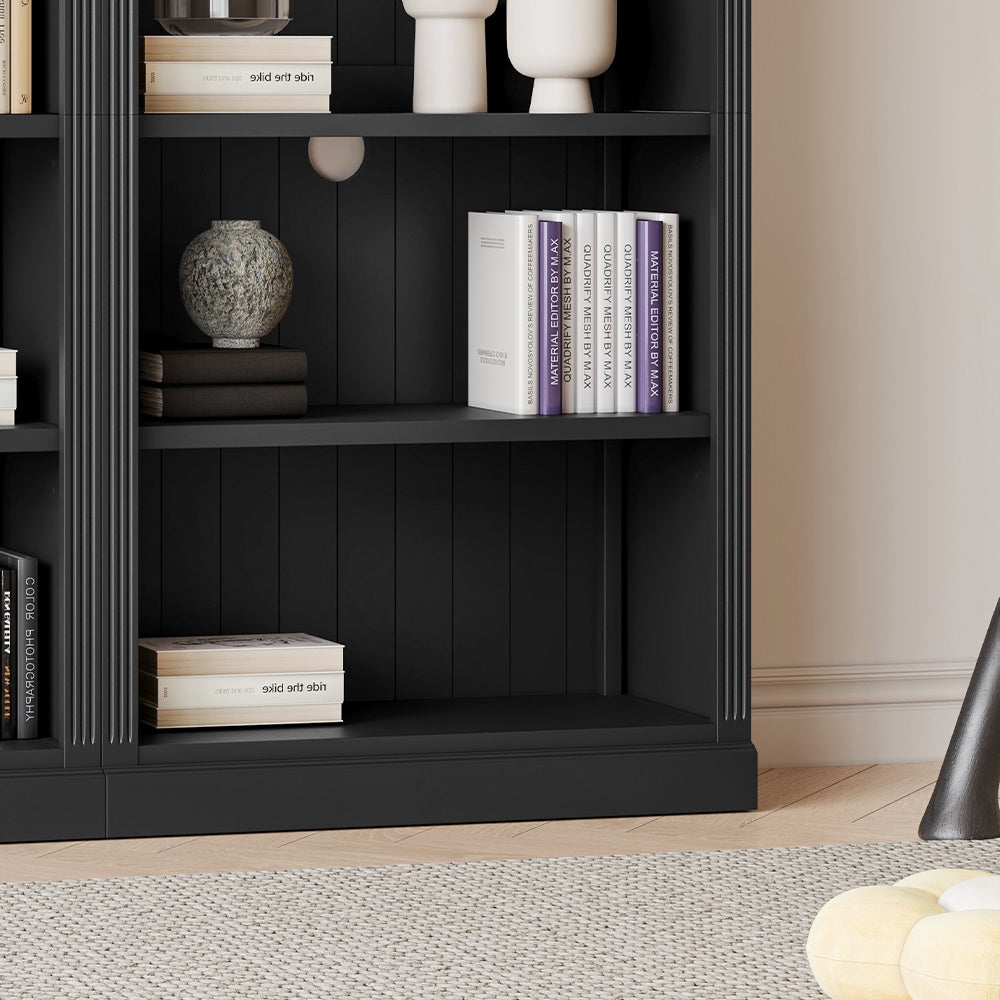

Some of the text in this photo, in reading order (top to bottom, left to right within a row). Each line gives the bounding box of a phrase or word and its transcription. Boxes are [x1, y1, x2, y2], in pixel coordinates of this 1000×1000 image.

[528, 283, 534, 292] OF
[564, 270, 572, 284] BY
[583, 244, 591, 304] QUADRIFY
[603, 244, 612, 304] QUADRIFY
[624, 244, 632, 304] QUADRIFY
[650, 250, 658, 305] MATERIAL
[550, 238, 559, 386] MATERIAL EDITOR BY M.AX
[564, 287, 572, 323] MESH
[583, 306, 591, 340] MESH
[603, 306, 612, 340] MESH
[624, 306, 632, 340] MESH
[650, 308, 658, 349] EDITOR
[668, 334, 673, 345] OF
[564, 324, 572, 383] QUADRIFY
[583, 343, 591, 358] BY
[603, 343, 612, 358] BY
[624, 343, 632, 358] BY
[650, 352, 658, 367] BY
